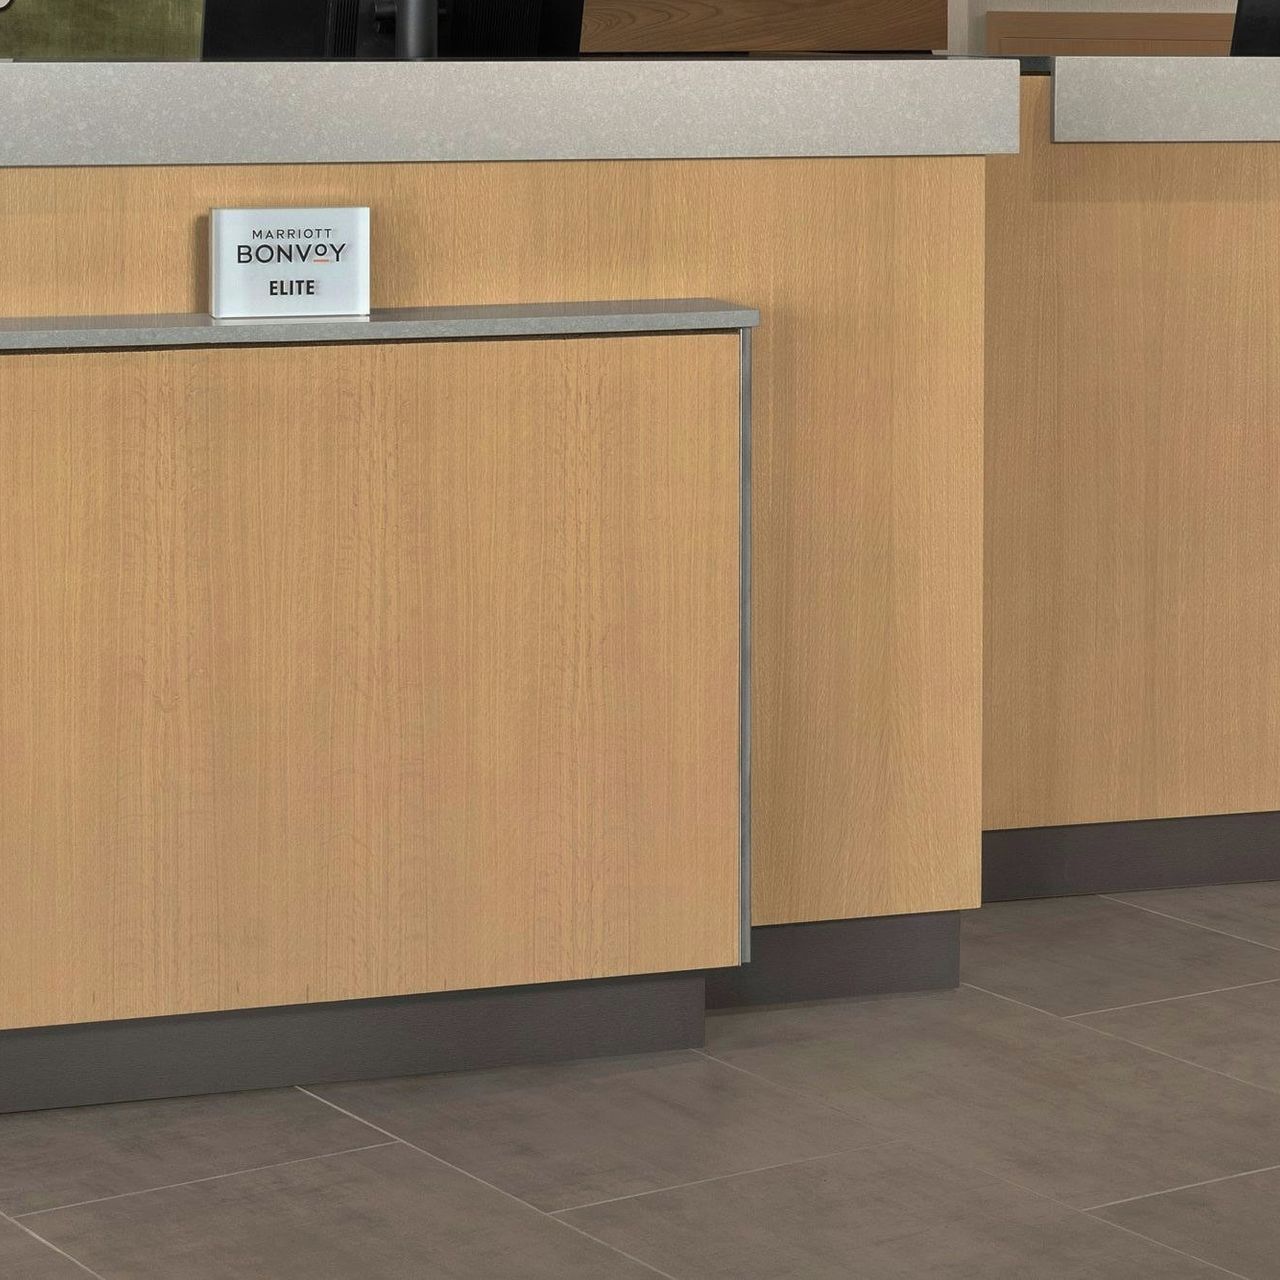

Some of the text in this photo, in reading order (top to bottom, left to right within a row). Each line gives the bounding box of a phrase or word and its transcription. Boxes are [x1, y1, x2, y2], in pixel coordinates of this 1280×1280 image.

[252, 228, 332, 240] MARRIOTT
[237, 243, 347, 264] BONVOY
[269, 279, 315, 296] ELITE
